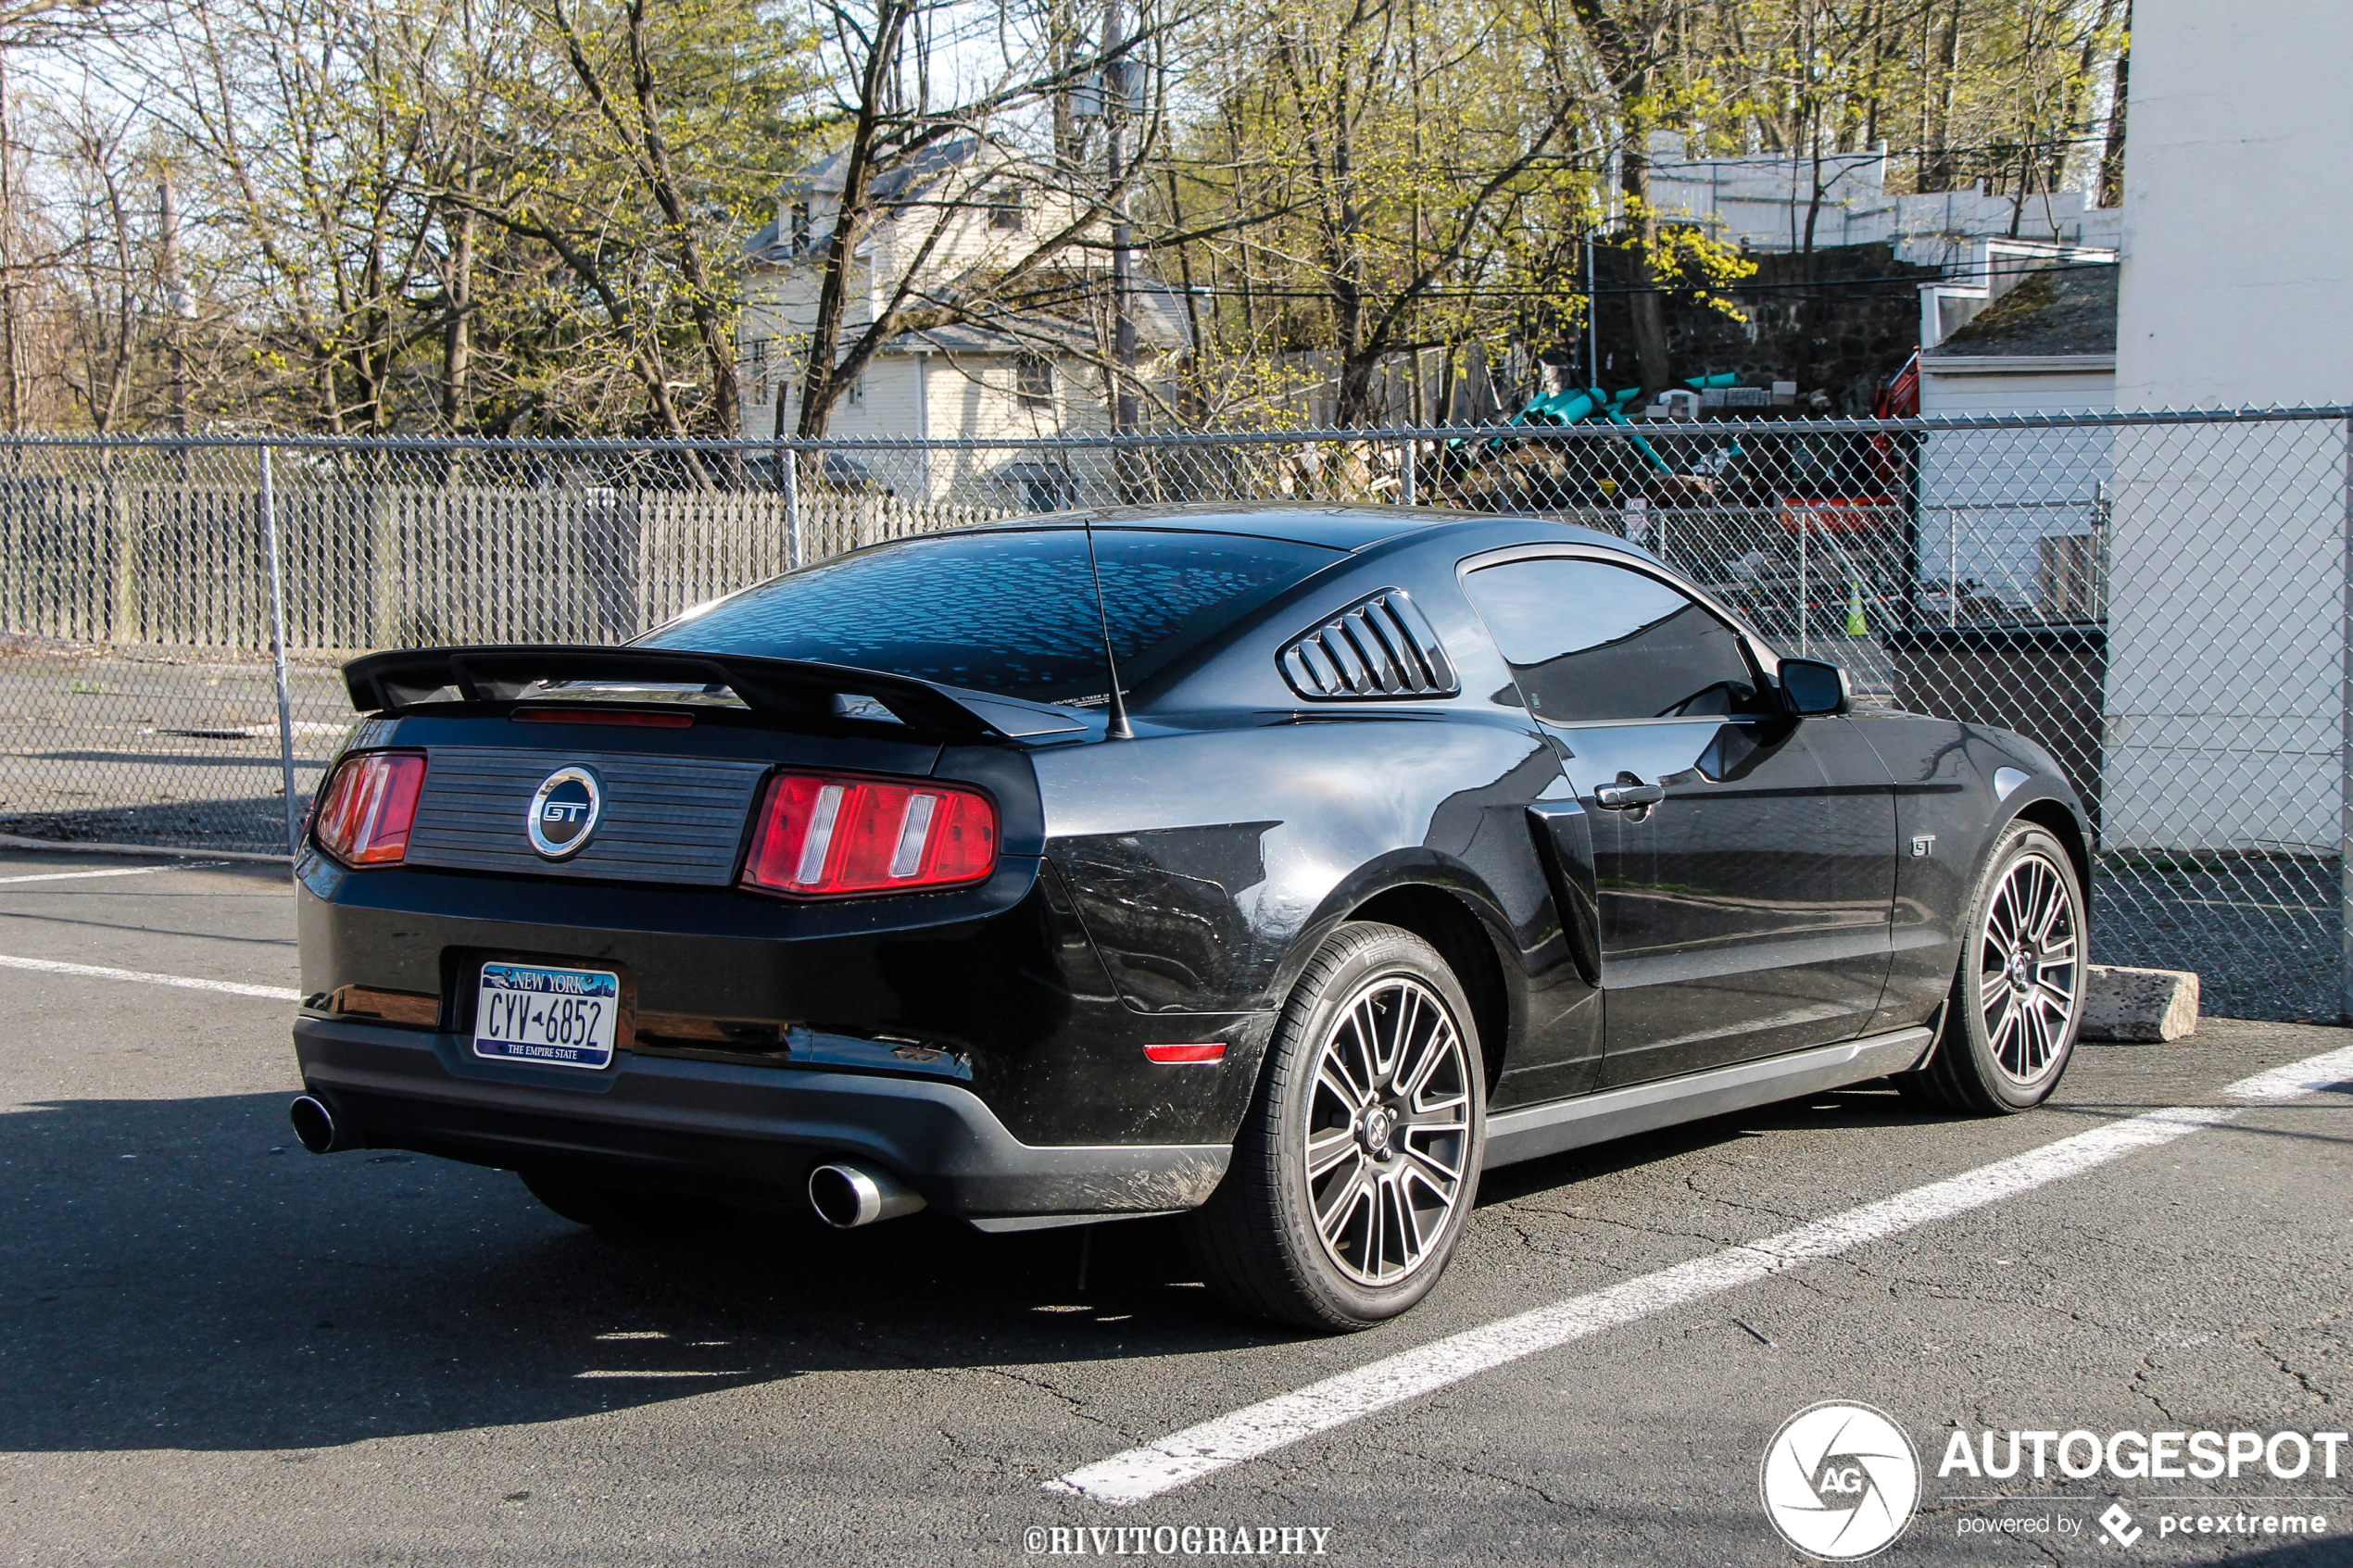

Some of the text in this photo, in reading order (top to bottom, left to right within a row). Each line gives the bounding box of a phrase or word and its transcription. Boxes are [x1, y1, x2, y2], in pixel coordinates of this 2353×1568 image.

[543, 801, 587, 822] GT
[1910, 834, 1936, 857] GT
[513, 971, 585, 994] NEW YORK
[489, 992, 602, 1047] CYV 6852
[508, 1044, 578, 1060] THE EMPIRE STATE
